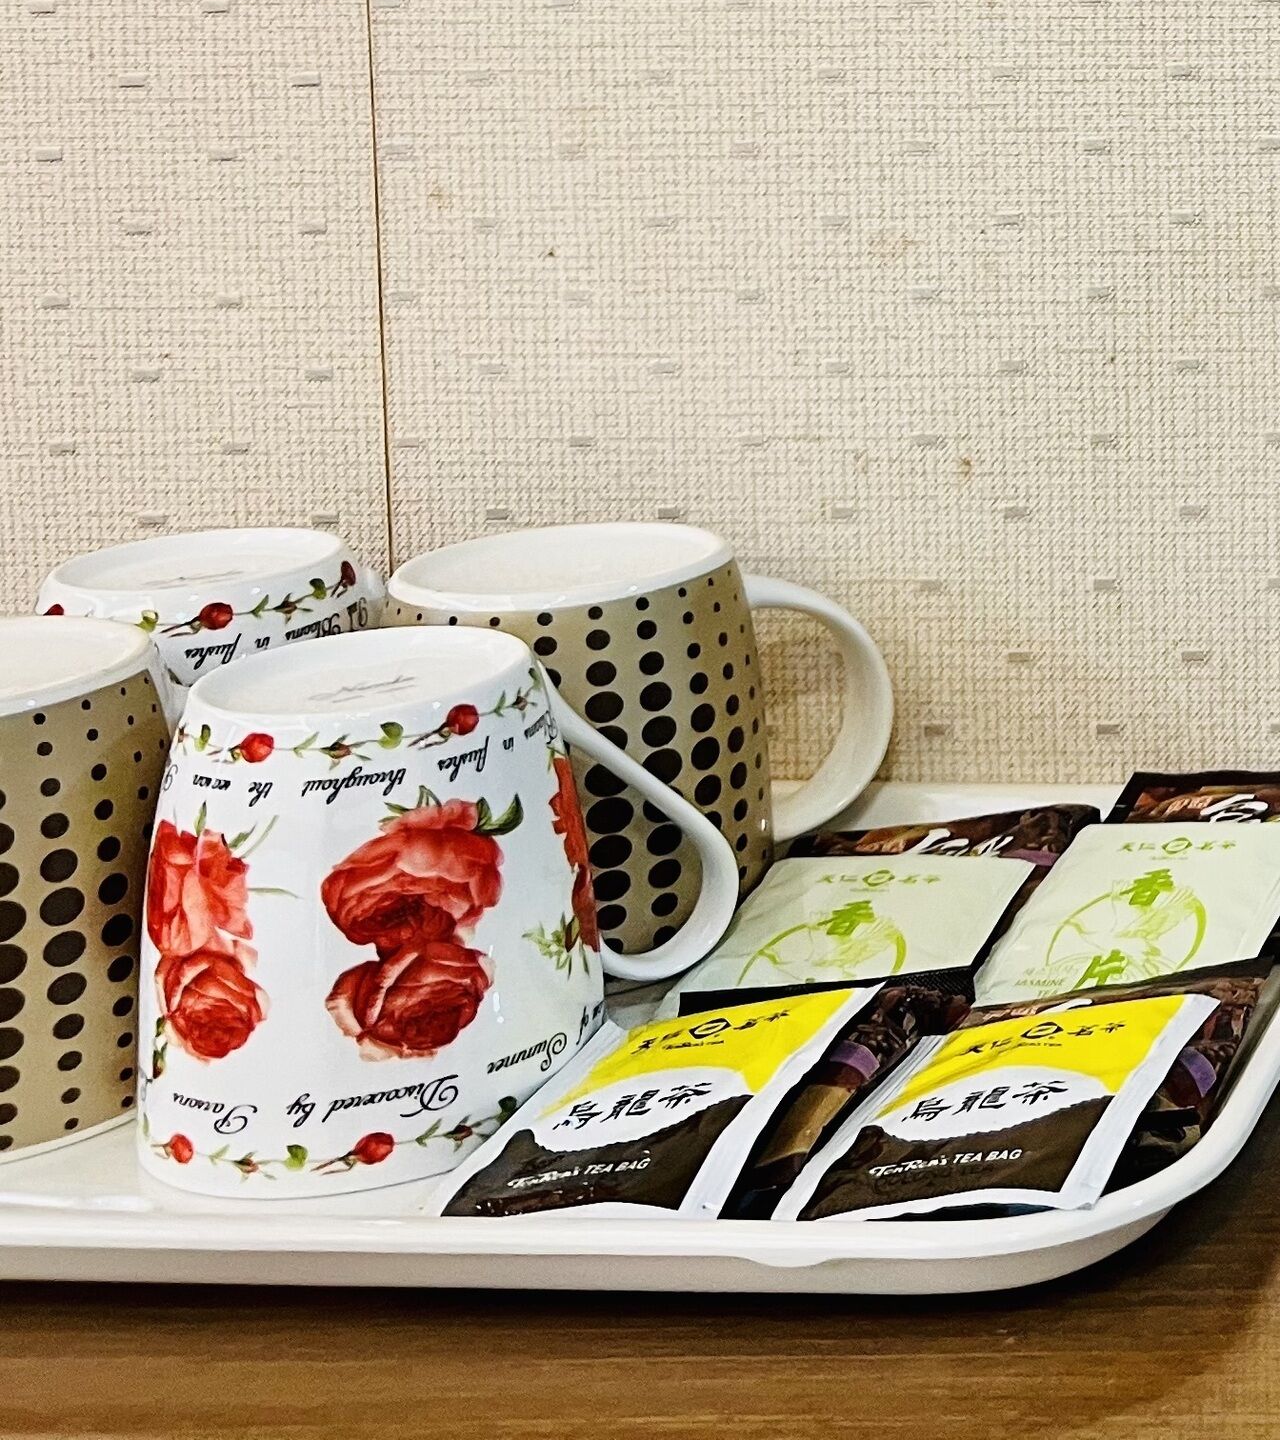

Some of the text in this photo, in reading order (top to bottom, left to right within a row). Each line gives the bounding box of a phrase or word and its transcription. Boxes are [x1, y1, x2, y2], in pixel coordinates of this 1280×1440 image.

[184, 633, 242, 670] flushes
[255, 637, 270, 650] in
[437, 734, 490, 782] flushes
[502, 737, 514, 752] in
[248, 780, 274, 807] the
[301, 765, 406, 805] throughout
[487, 1032, 567, 1075] Summer
[172, 1092, 258, 1134] Parsons
[286, 1093, 316, 1128] by
[322, 1074, 459, 1122] Discovered
[552, 1082, 713, 1130] 烏龍茶
[901, 1080, 1069, 1123] 烏龍茶
[583, 1163, 613, 1176] TEA
[615, 1157, 652, 1172] BAG
[952, 1151, 984, 1165] TEA
[985, 1148, 1024, 1162] BAG
